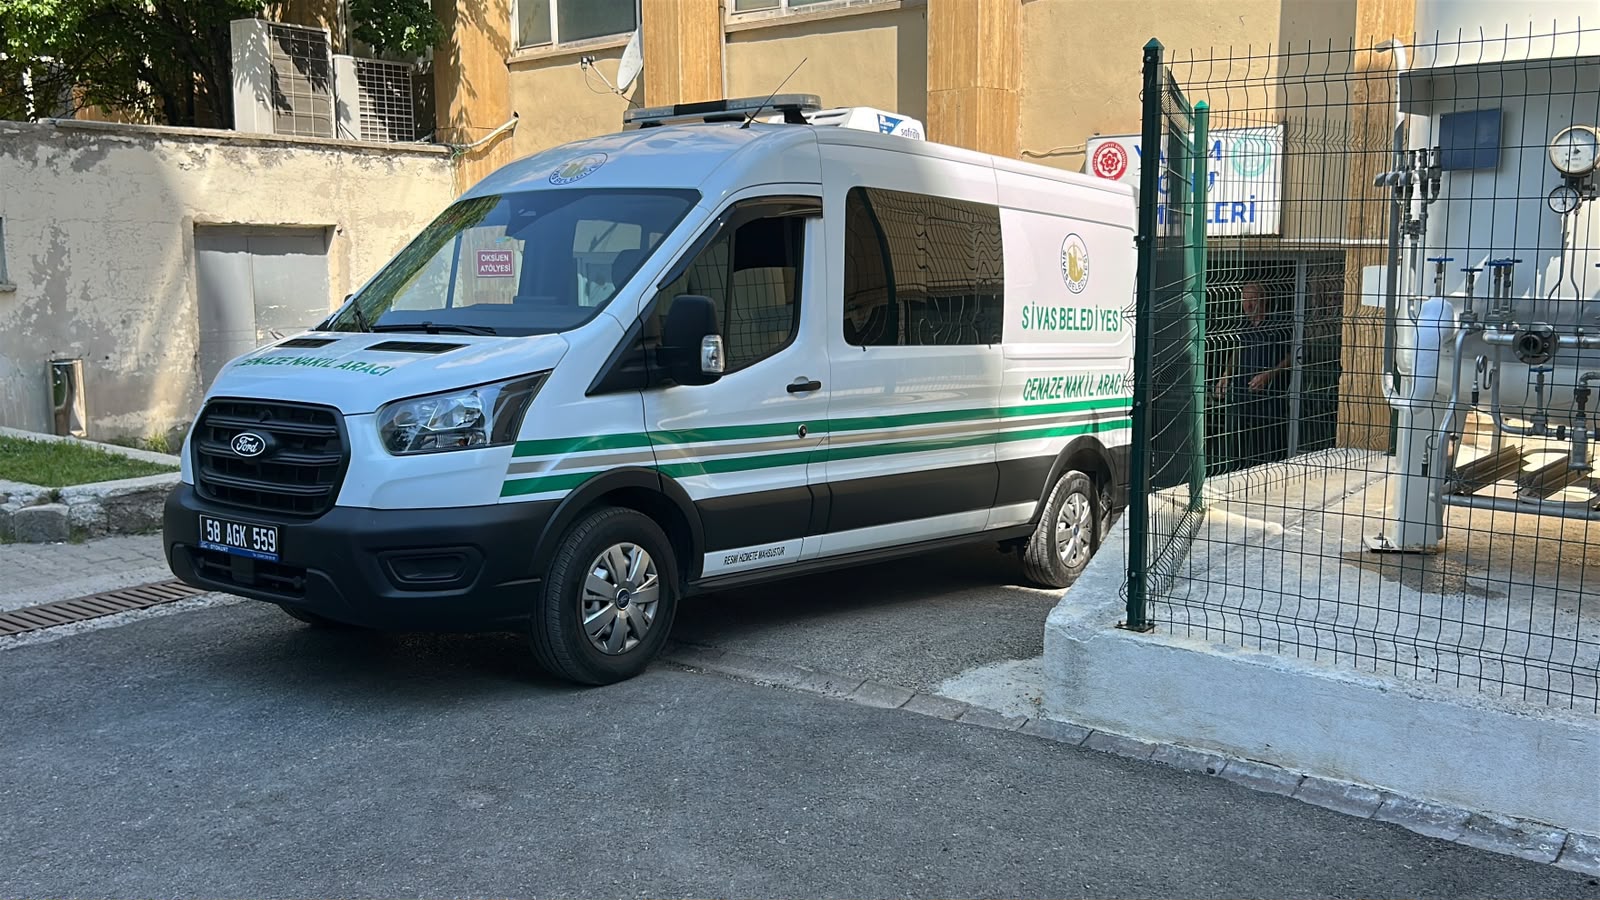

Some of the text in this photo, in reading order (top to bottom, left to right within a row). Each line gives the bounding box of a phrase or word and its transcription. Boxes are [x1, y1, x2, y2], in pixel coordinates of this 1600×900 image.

[480, 253, 509, 262] OKSİJEN
[480, 263, 511, 272] ATÖLYESİ
[1021, 301, 1123, 333] SİVAS BELEDİYESİ
[1022, 376, 1064, 401] CENAZE
[1063, 371, 1094, 399] NAKİL
[236, 436, 259, 453] Ford
[206, 519, 276, 553] 58 AGK 559
